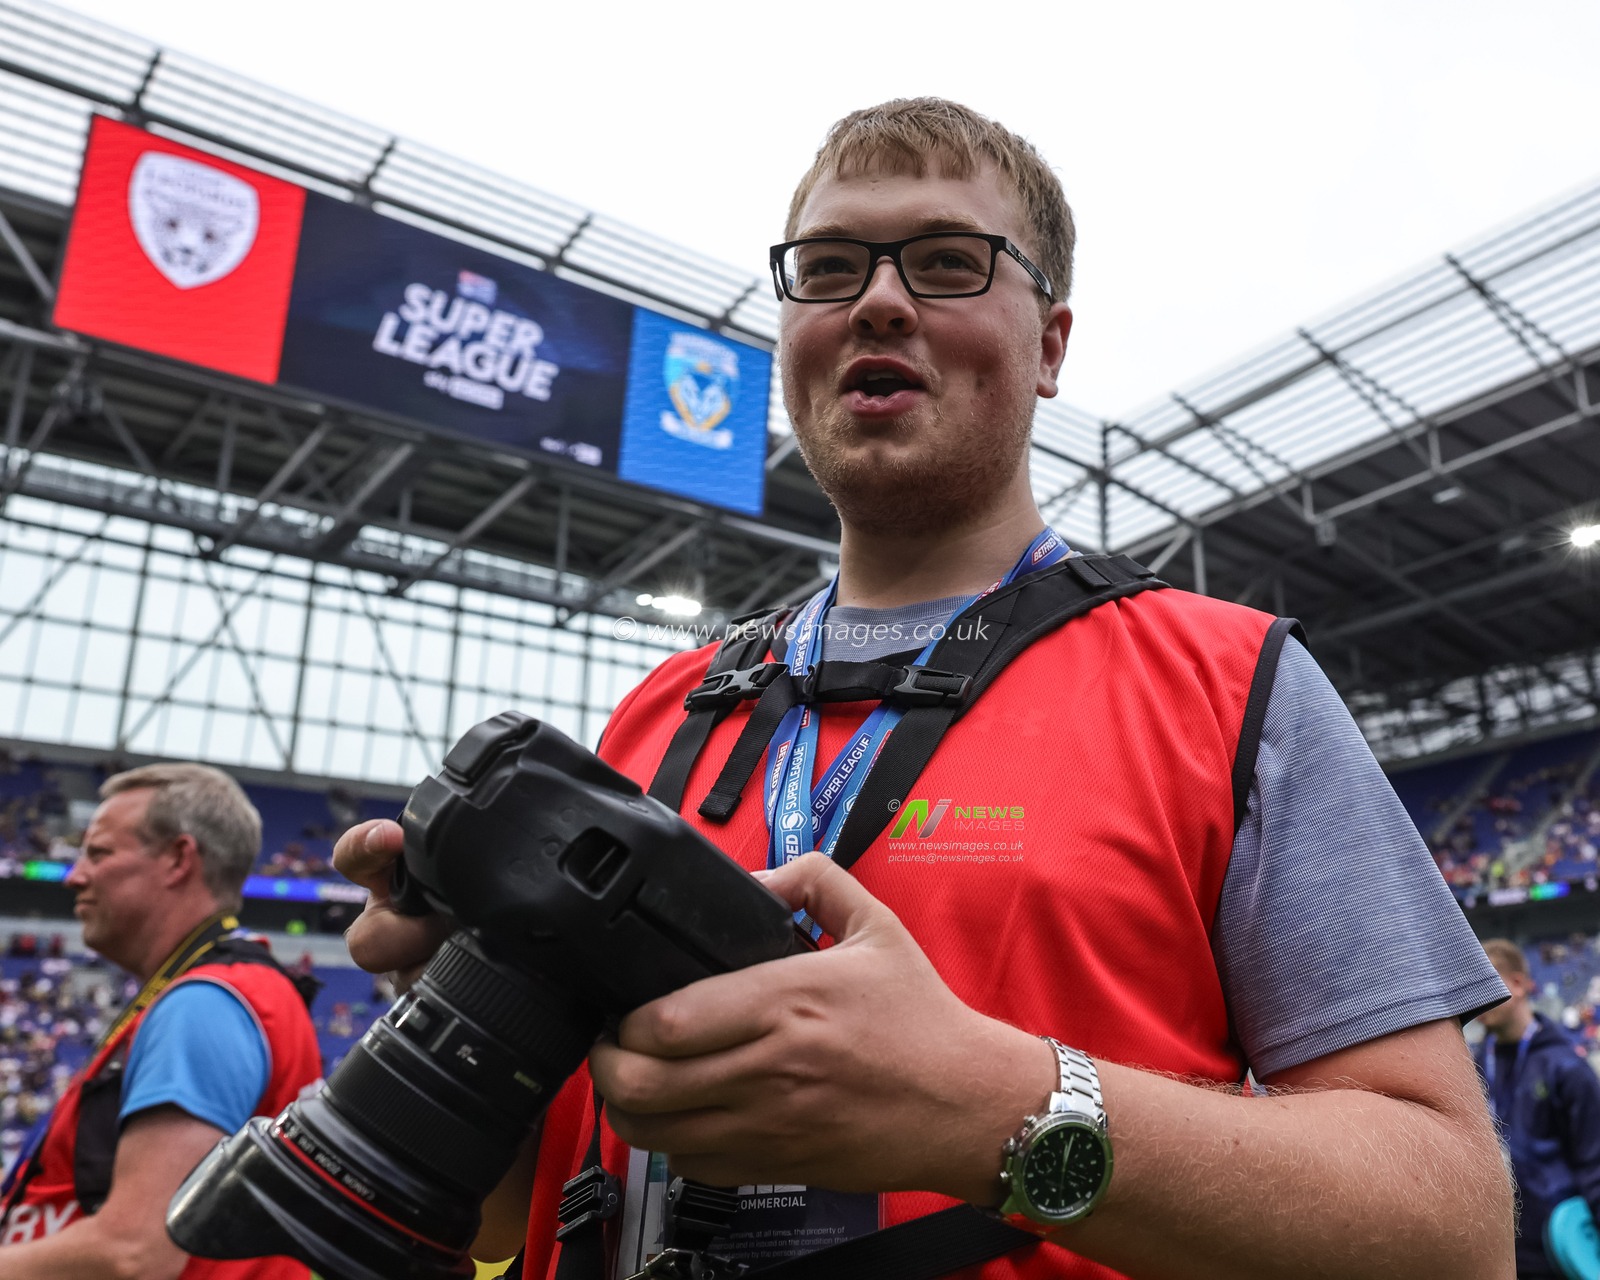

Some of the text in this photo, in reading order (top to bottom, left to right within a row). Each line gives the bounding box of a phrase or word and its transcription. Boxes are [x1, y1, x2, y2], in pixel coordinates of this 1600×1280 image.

[398, 282, 545, 358] SUPER
[372, 311, 560, 401] LEAGUE
[1033, 536, 1058, 562] BETFRED
[794, 643, 808, 667] SUPER
[771, 745, 789, 789] BETFRED
[785, 744, 805, 811] SUPER LEAGUE
[814, 776, 840, 812] SUPER
[840, 736, 870, 781] LEAGUE
[740, 1196, 807, 1211] OMMERCIAL
[788, 1239, 800, 1247] the
[800, 1237, 834, 1247] condition
[793, 1227, 806, 1236] the
[806, 1225, 836, 1237] property
[836, 1225, 845, 1235] of
